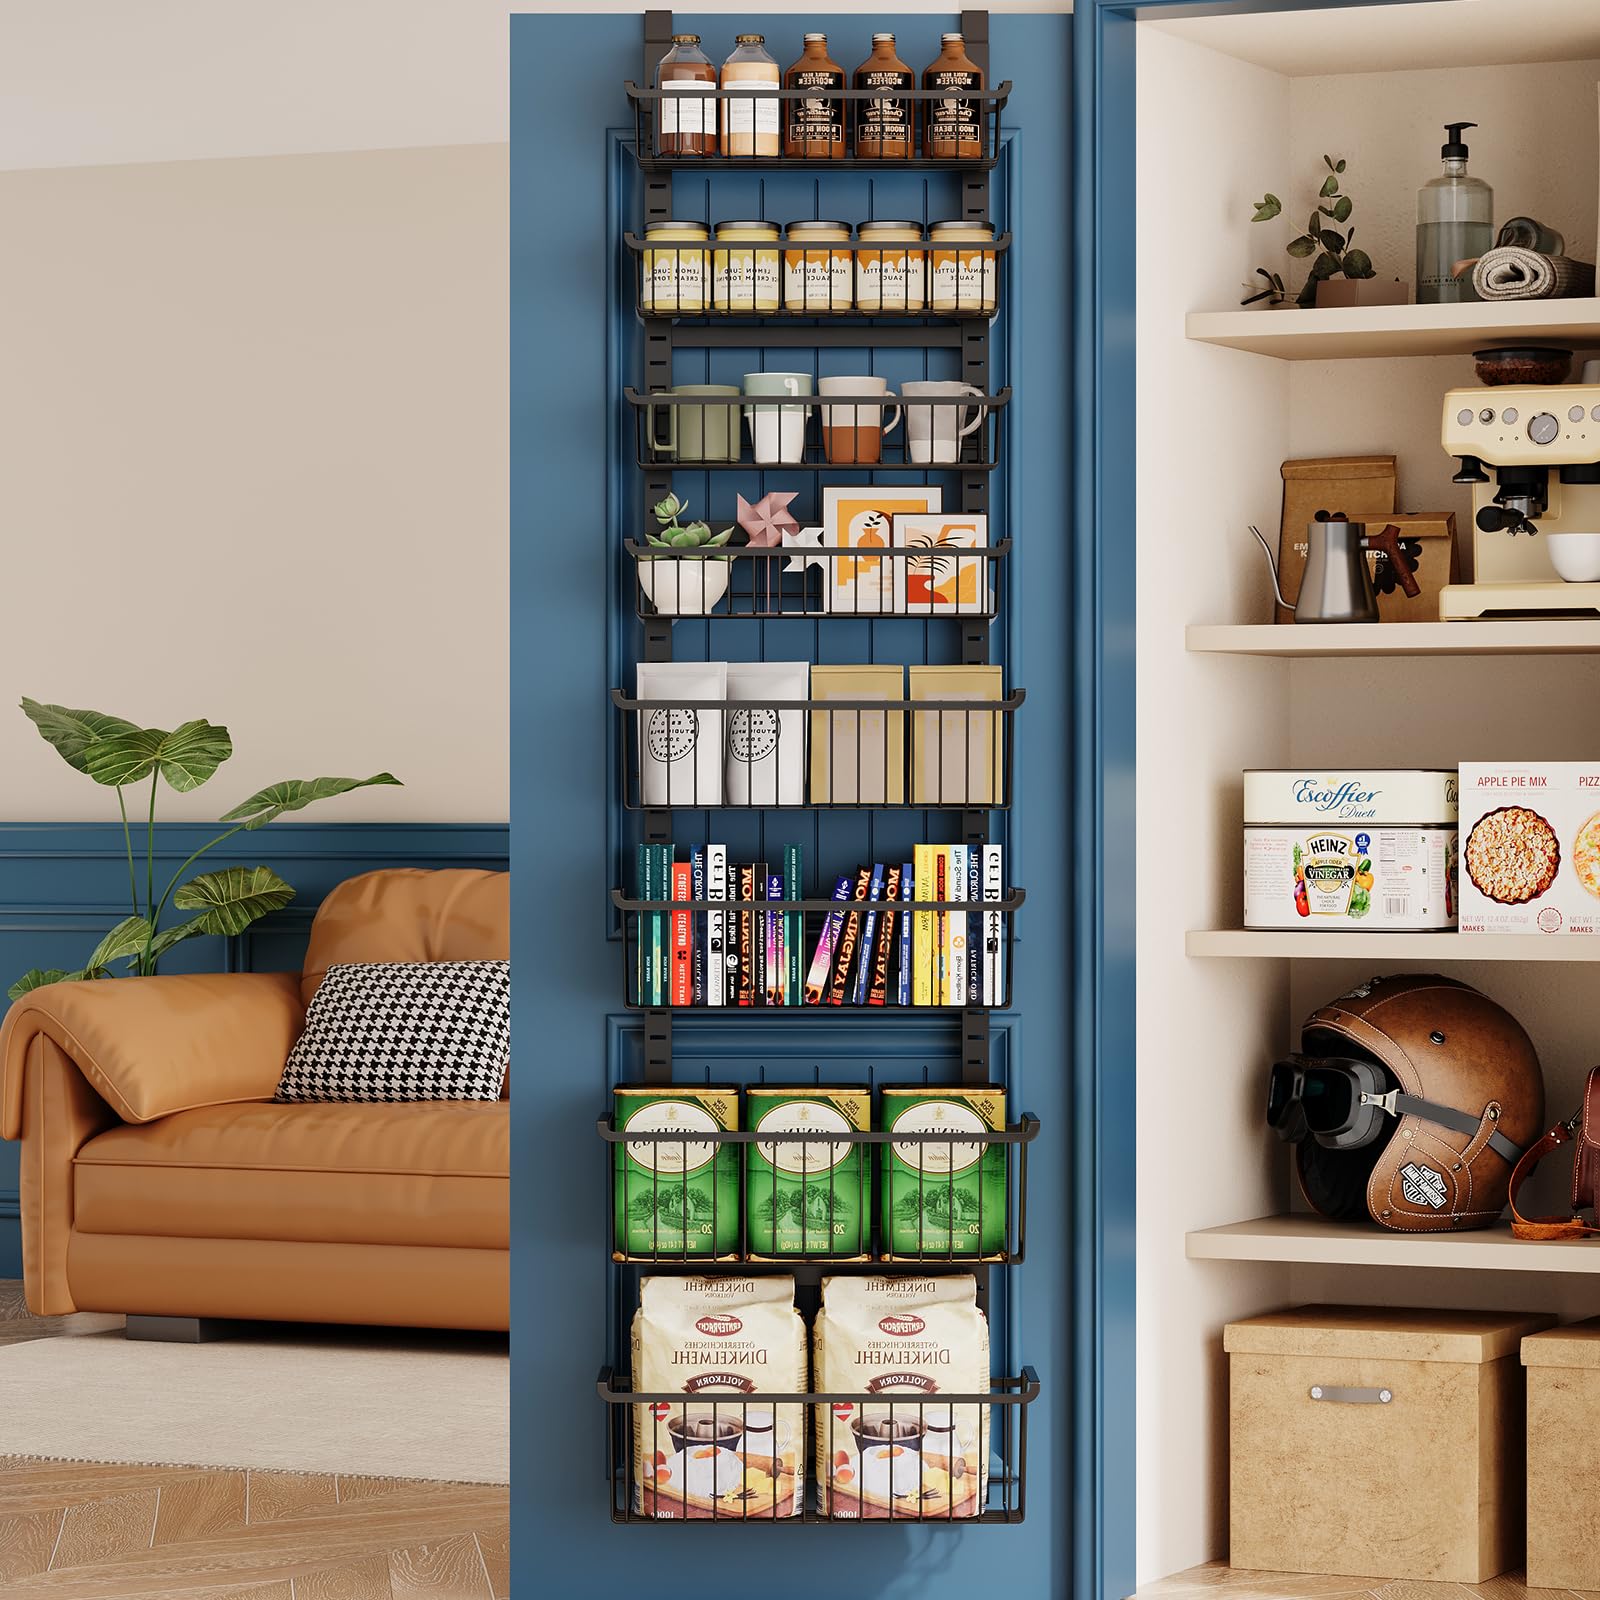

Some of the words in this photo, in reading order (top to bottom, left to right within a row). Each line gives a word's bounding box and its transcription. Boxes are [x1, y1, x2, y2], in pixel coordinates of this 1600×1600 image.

[1478, 776, 1508, 786] APPLE
[1511, 776, 1526, 786] PIE
[1529, 776, 1547, 786] MIX
[1293, 780, 1382, 811] Escoffier
[1339, 804, 1376, 818] Duett
[1311, 839, 1347, 855] HEINZ
